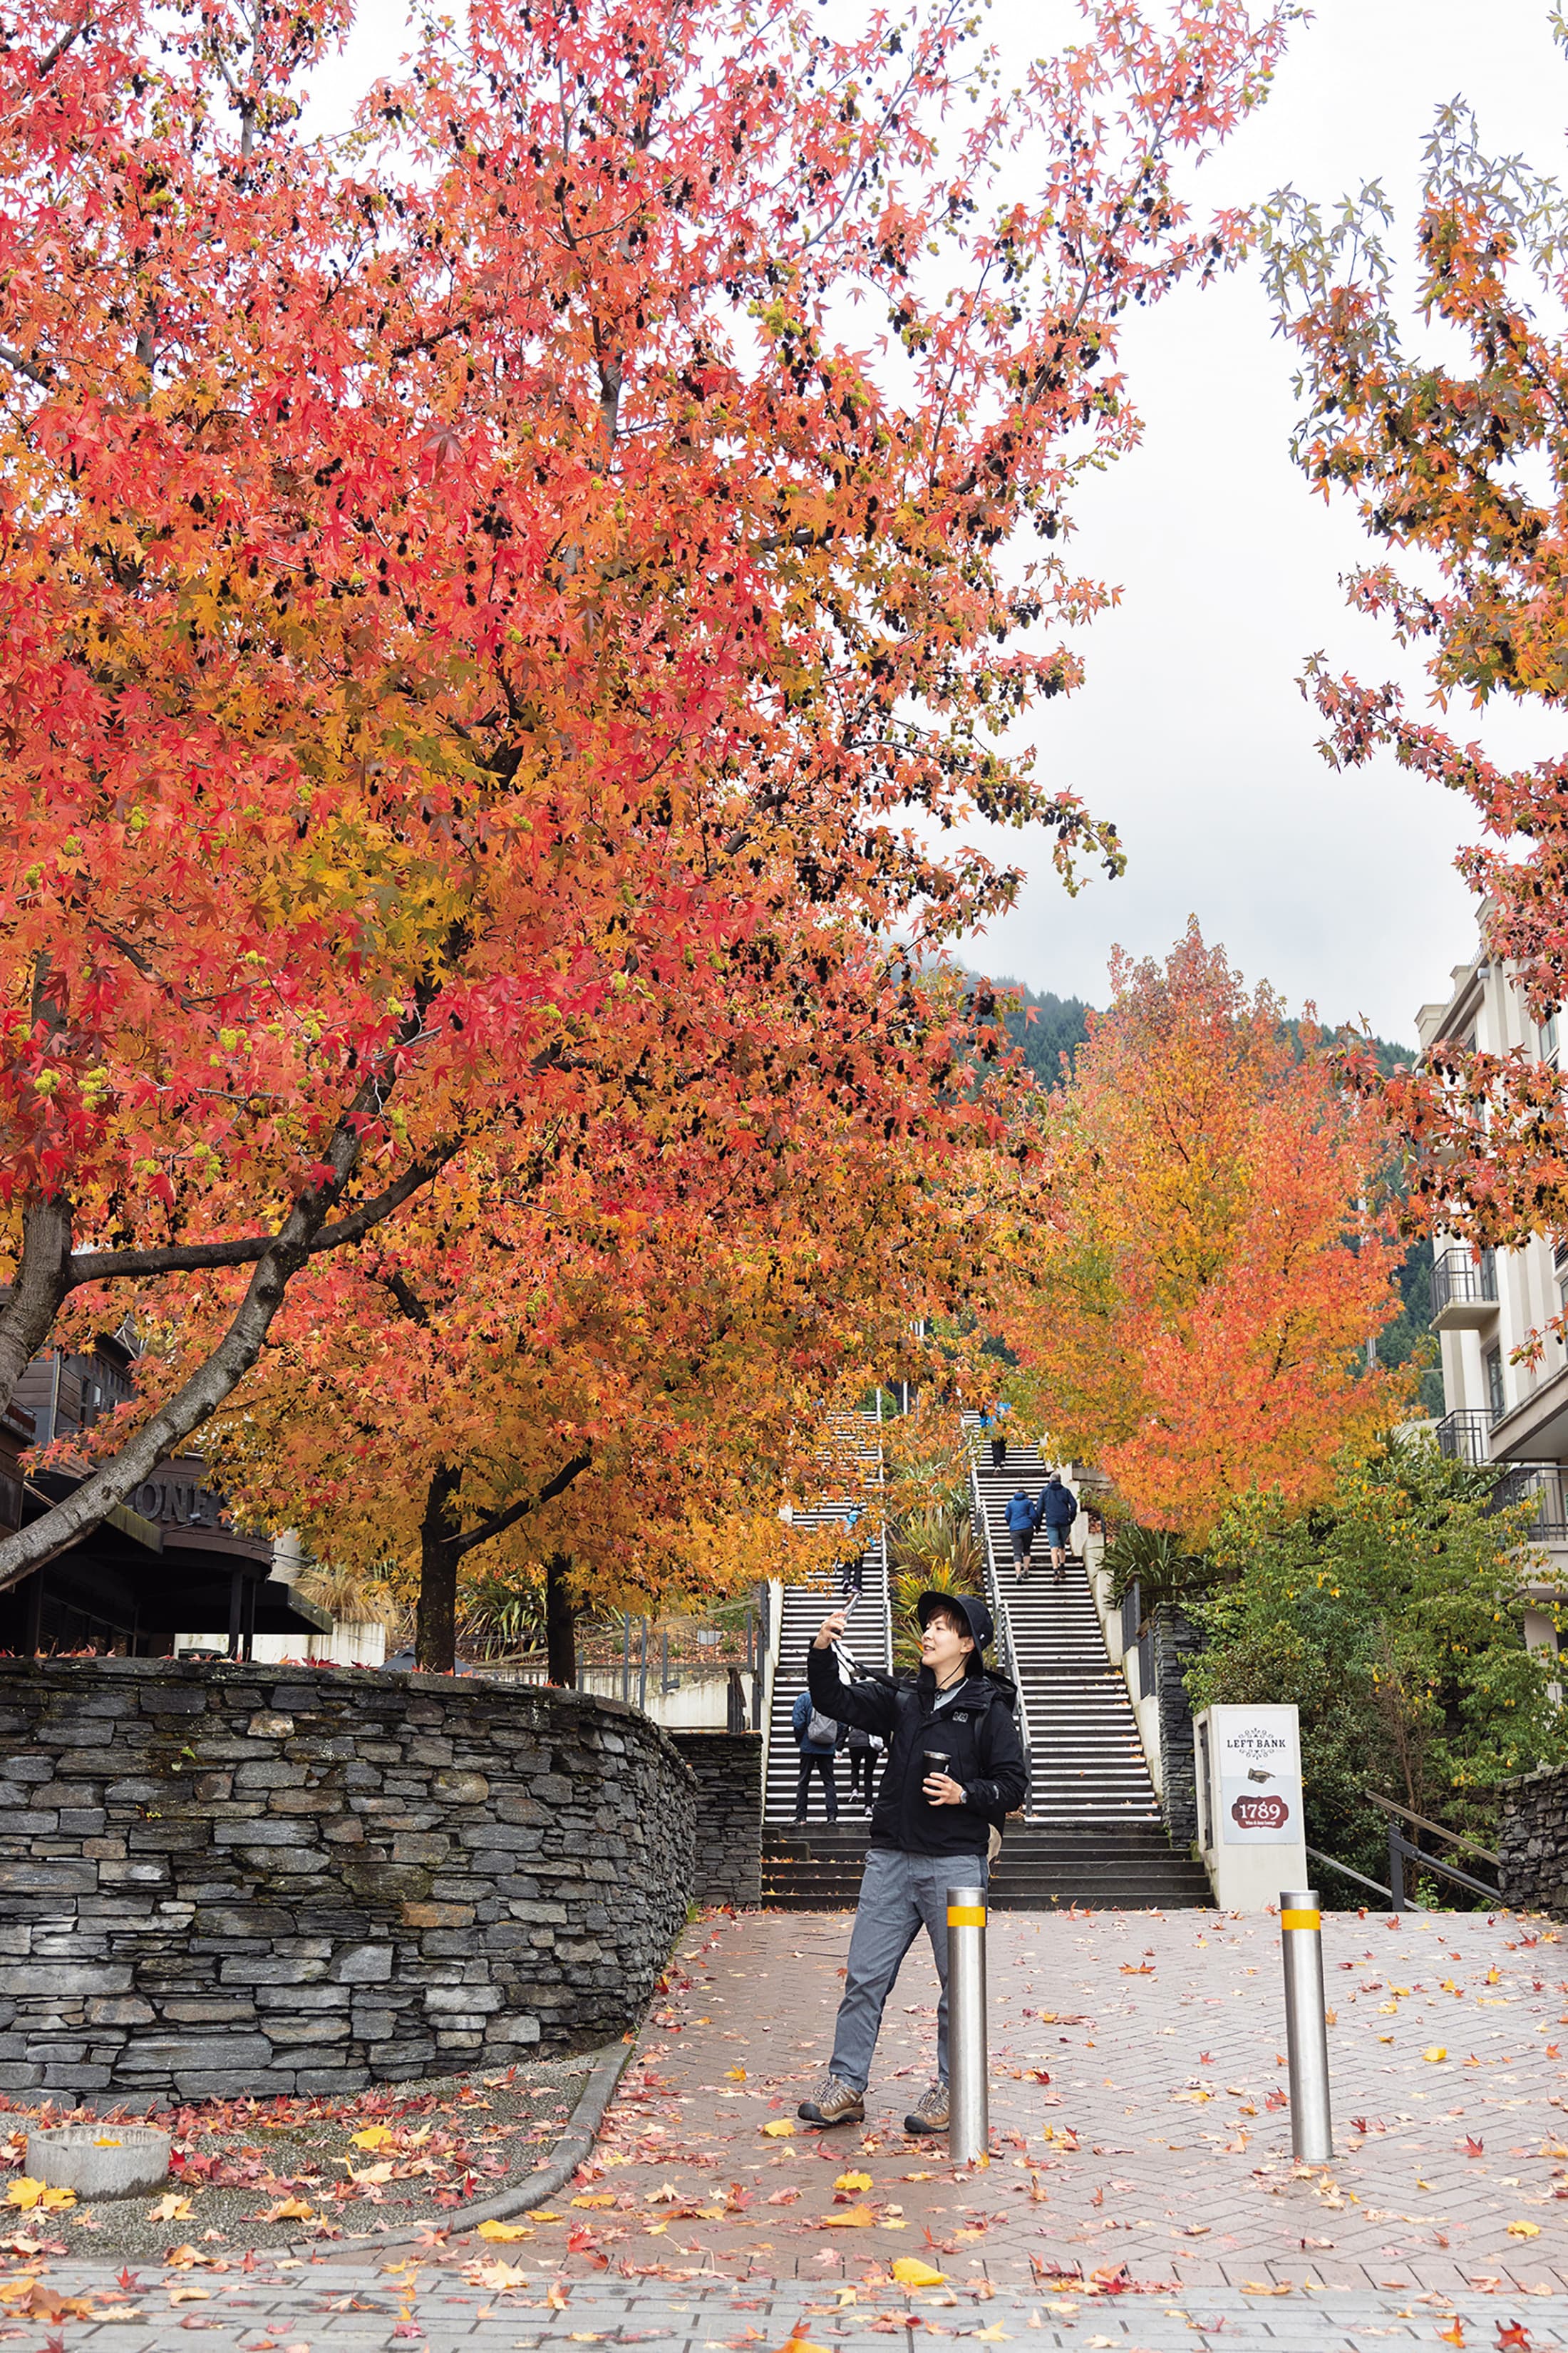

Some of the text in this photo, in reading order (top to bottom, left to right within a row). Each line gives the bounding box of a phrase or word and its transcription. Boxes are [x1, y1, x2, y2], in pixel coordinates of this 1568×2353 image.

[124, 1477, 214, 1527] ONE
[1227, 1739, 1286, 1748] LEFT BANK
[1239, 1801, 1281, 1820] 1789
